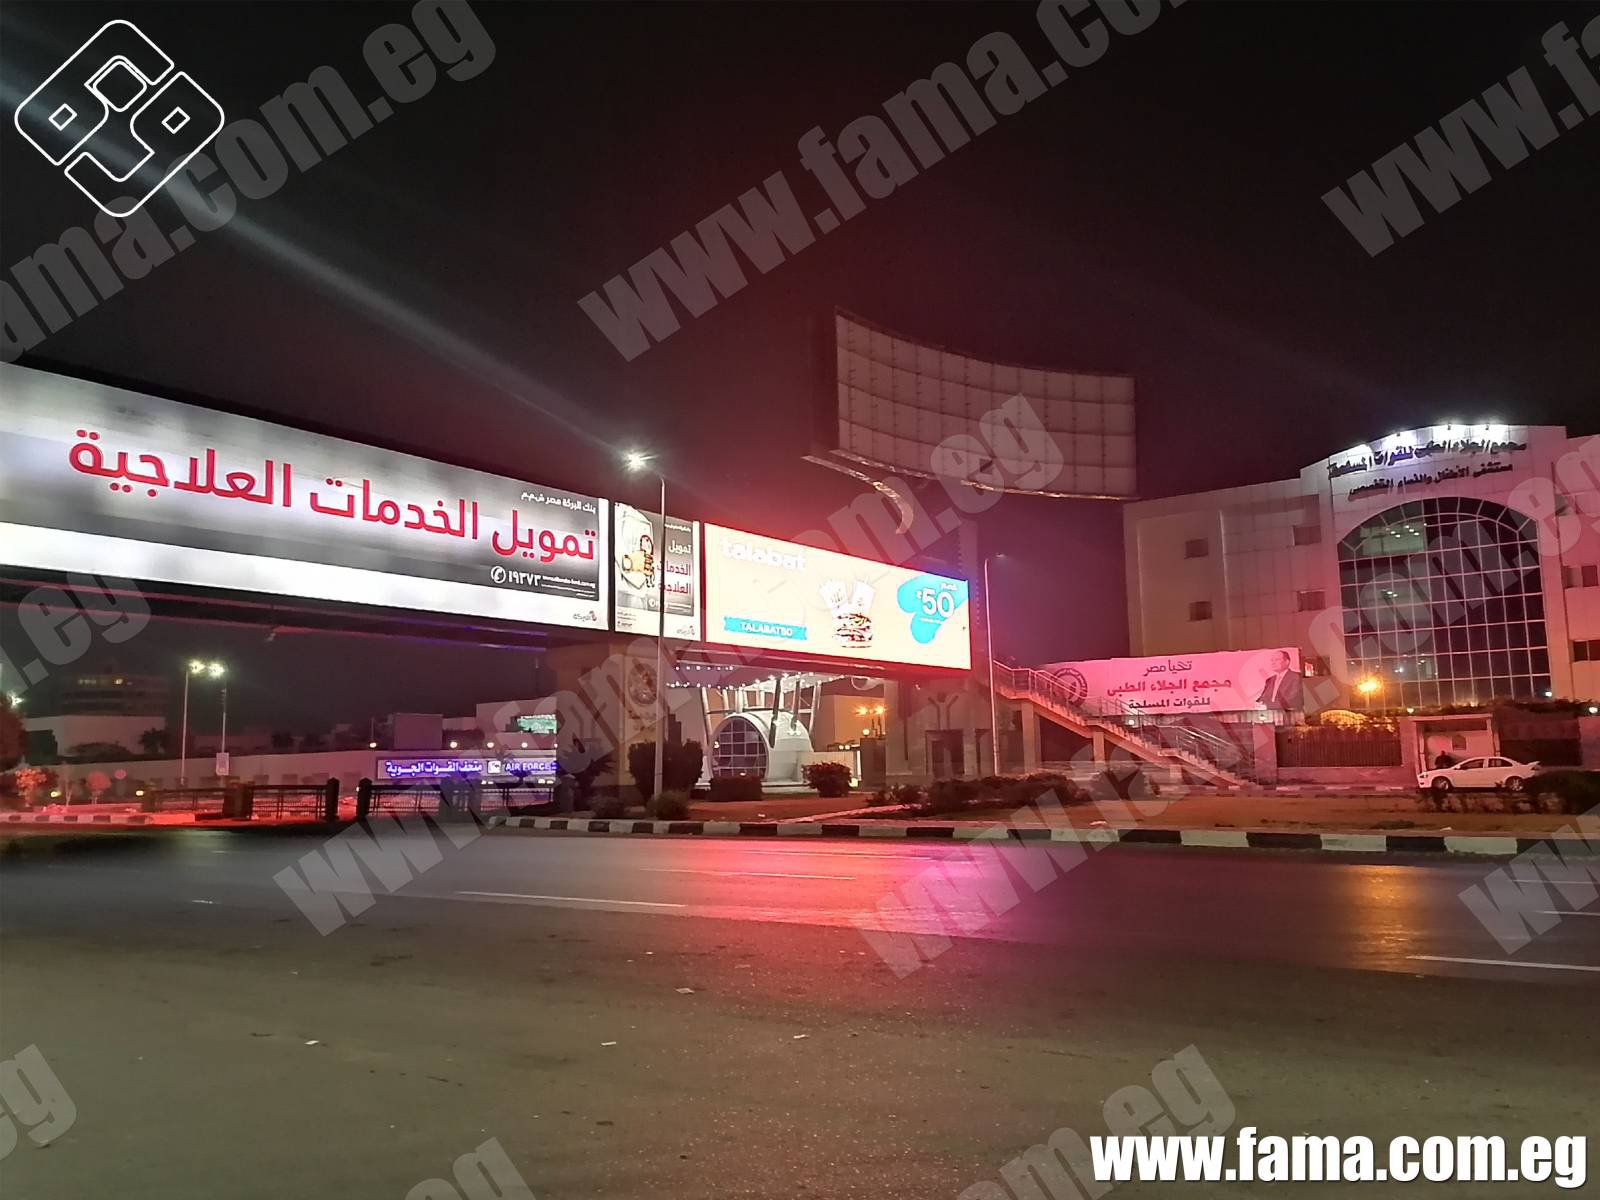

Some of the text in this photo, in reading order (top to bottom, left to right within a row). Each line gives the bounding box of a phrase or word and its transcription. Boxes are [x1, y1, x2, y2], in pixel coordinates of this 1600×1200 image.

[69, 429, 597, 562] تمويل الخدمات العلاجية
[668, 540, 691, 554] تمويل
[721, 538, 806, 570] talabat
[1143, 665, 1167, 677] مصر
[1150, 678, 1187, 695] الجلاء
[1192, 678, 1232, 693] مجمع
[1128, 696, 1211, 710] للقوات المسلحة
[505, 762, 520, 771] AIR
